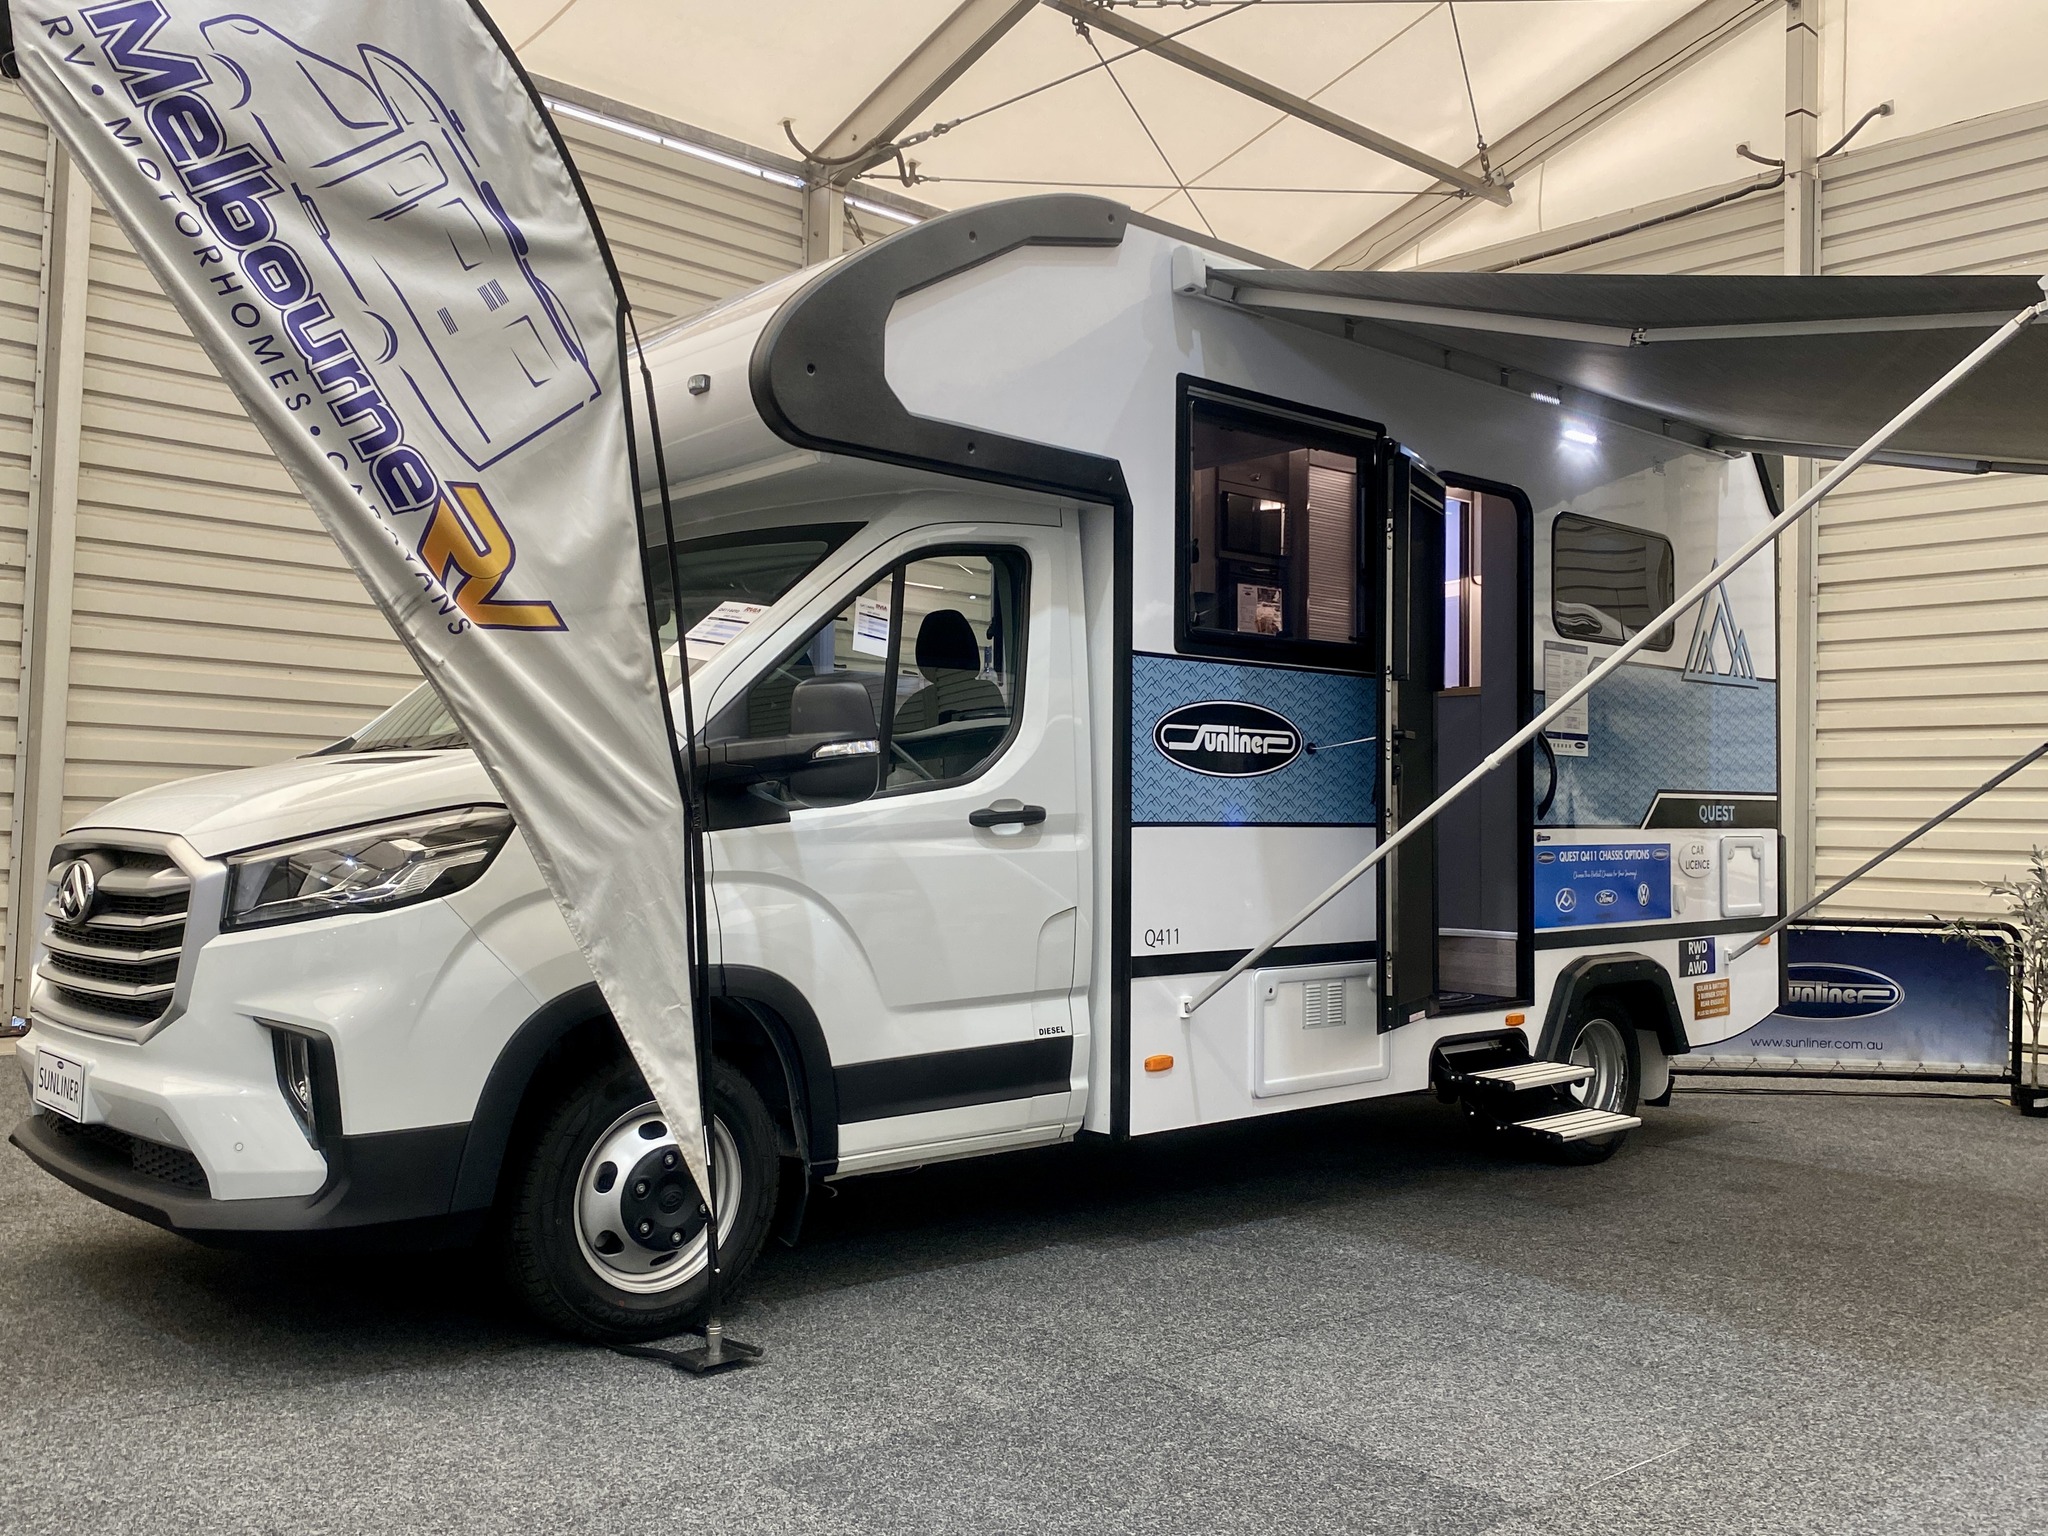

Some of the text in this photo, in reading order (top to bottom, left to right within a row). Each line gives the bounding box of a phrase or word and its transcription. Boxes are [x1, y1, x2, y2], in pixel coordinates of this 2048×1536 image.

[78, 0, 438, 515] Melbourne
[40, 16, 96, 66] RV
[326, 451, 472, 635] CANS
[1161, 724, 1296, 754] Sunliner
[1699, 804, 1735, 824] QUEST
[1559, 851, 1579, 862] QUEST
[1580, 850, 1597, 861] Q411
[1598, 849, 1624, 861] CHASSIS
[1624, 849, 1650, 860] OPTIONS
[1691, 845, 1704, 857] CAR
[1685, 860, 1710, 870] LICENCE
[1144, 928, 1180, 947] Q411
[1688, 940, 1708, 955] RWD
[1687, 960, 1708, 975] AWD
[1788, 980, 1898, 1004] unliner
[1038, 1026, 1065, 1035] DIESEL
[1750, 1037, 1883, 1050] www.sunliner.com.au
[39, 1067, 79, 1104] SUNLINER
